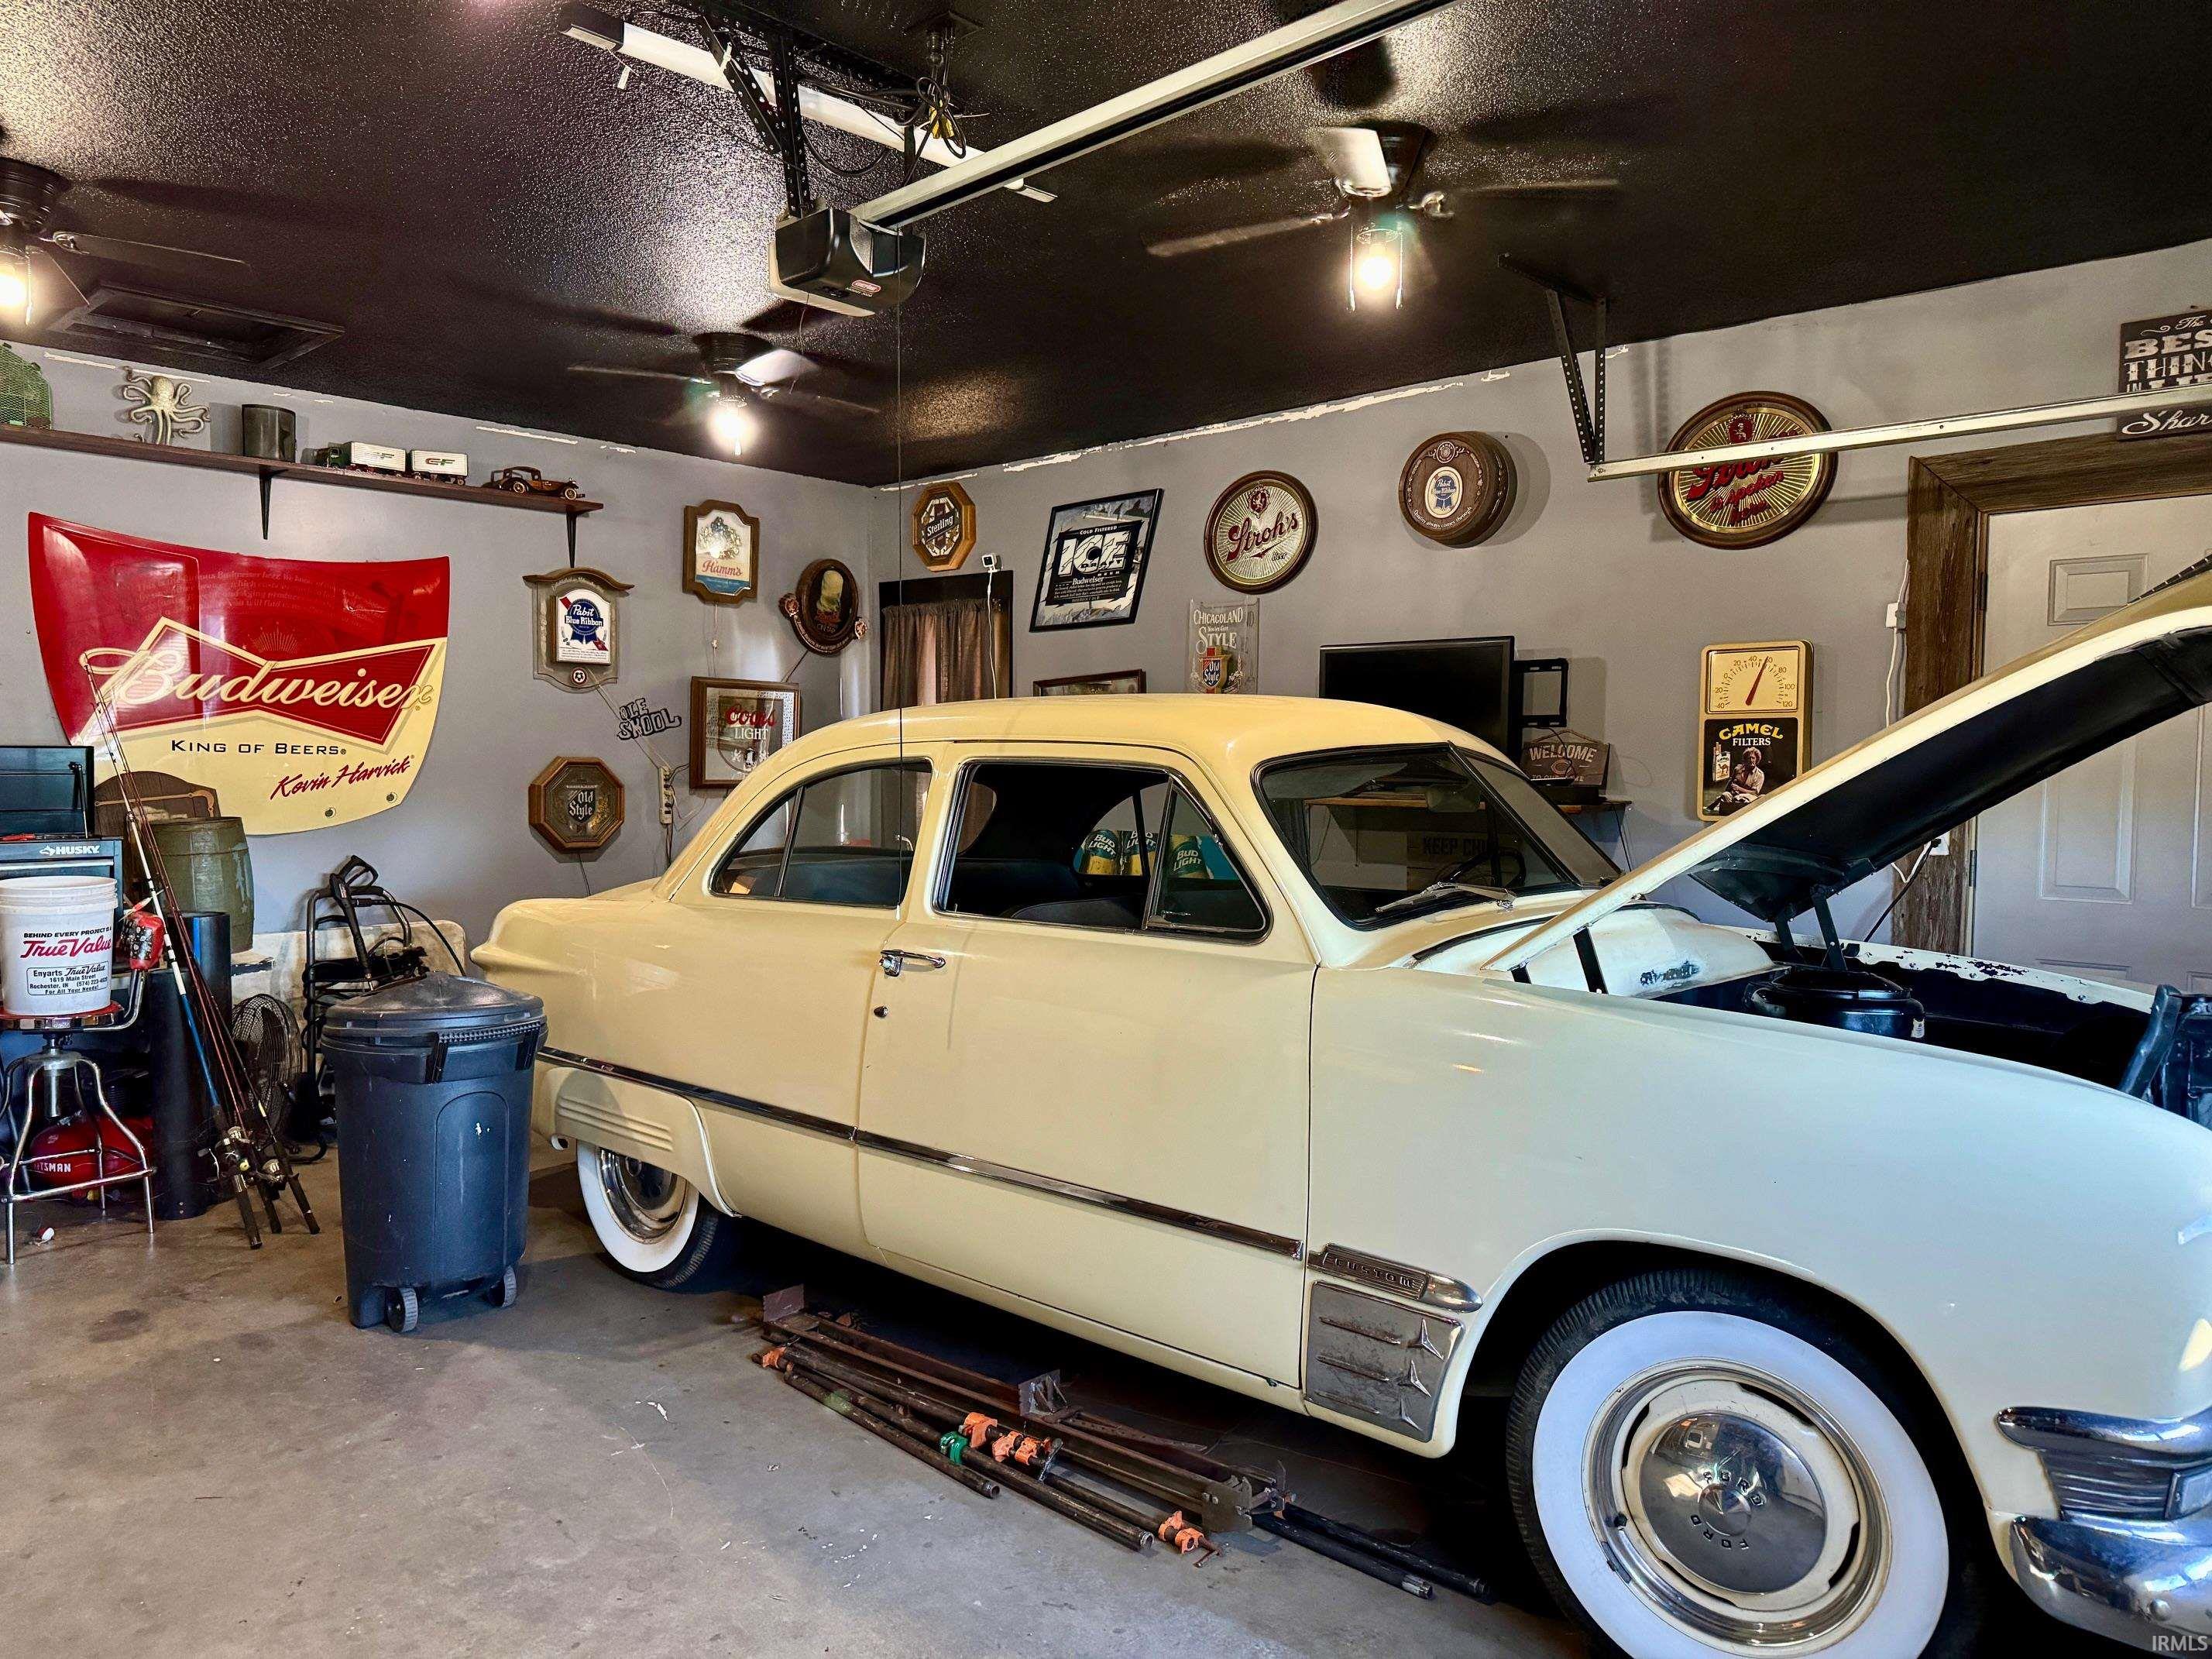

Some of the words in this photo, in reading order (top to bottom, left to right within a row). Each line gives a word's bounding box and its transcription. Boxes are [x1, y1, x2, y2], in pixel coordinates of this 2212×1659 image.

[2175, 315, 2207, 330] The
[2124, 351, 2212, 381] THIN
[1727, 470, 1784, 507] spoken
[927, 516, 953, 536] Sterling
[1226, 511, 1298, 562] Stroh's
[1058, 531, 1131, 577] ICE
[1272, 552, 1287, 561] Beer
[702, 560, 743, 576] Hamm's
[1080, 558, 1123, 569] DRAFT
[1072, 576, 1104, 586] Budweiser
[573, 604, 594, 617] Pabst
[1194, 607, 1243, 625] CHICAGOLAND
[565, 616, 579, 624] Blue
[580, 617, 603, 627] Ribbon
[1196, 626, 1237, 655] STYLE
[1209, 661, 1221, 672] Old
[79, 647, 434, 711] Budweiser
[1204, 668, 1220, 685] Style
[726, 703, 777, 726] Coors
[617, 708, 682, 740] SKOOL
[1719, 723, 1784, 740] CAMEL
[734, 728, 768, 740] LIGHT
[171, 740, 226, 752] KING
[239, 744, 264, 754] OF
[1733, 737, 1771, 747] FILTERS
[1529, 744, 1597, 763] WELCOME
[270, 773, 331, 800] Kevin
[331, 755, 410, 788] Harvick
[578, 791, 594, 803] Old
[568, 802, 593, 820] Style
[1094, 834, 1115, 848] BUD
[1130, 830, 1153, 839] BD
[56, 846, 101, 855] HUSKY
[1088, 841, 1116, 855] LIGHT
[1176, 850, 1199, 860] BUD
[1173, 857, 1202, 871] LIGHT
[1334, 1258, 1413, 1287] CUSTOM
